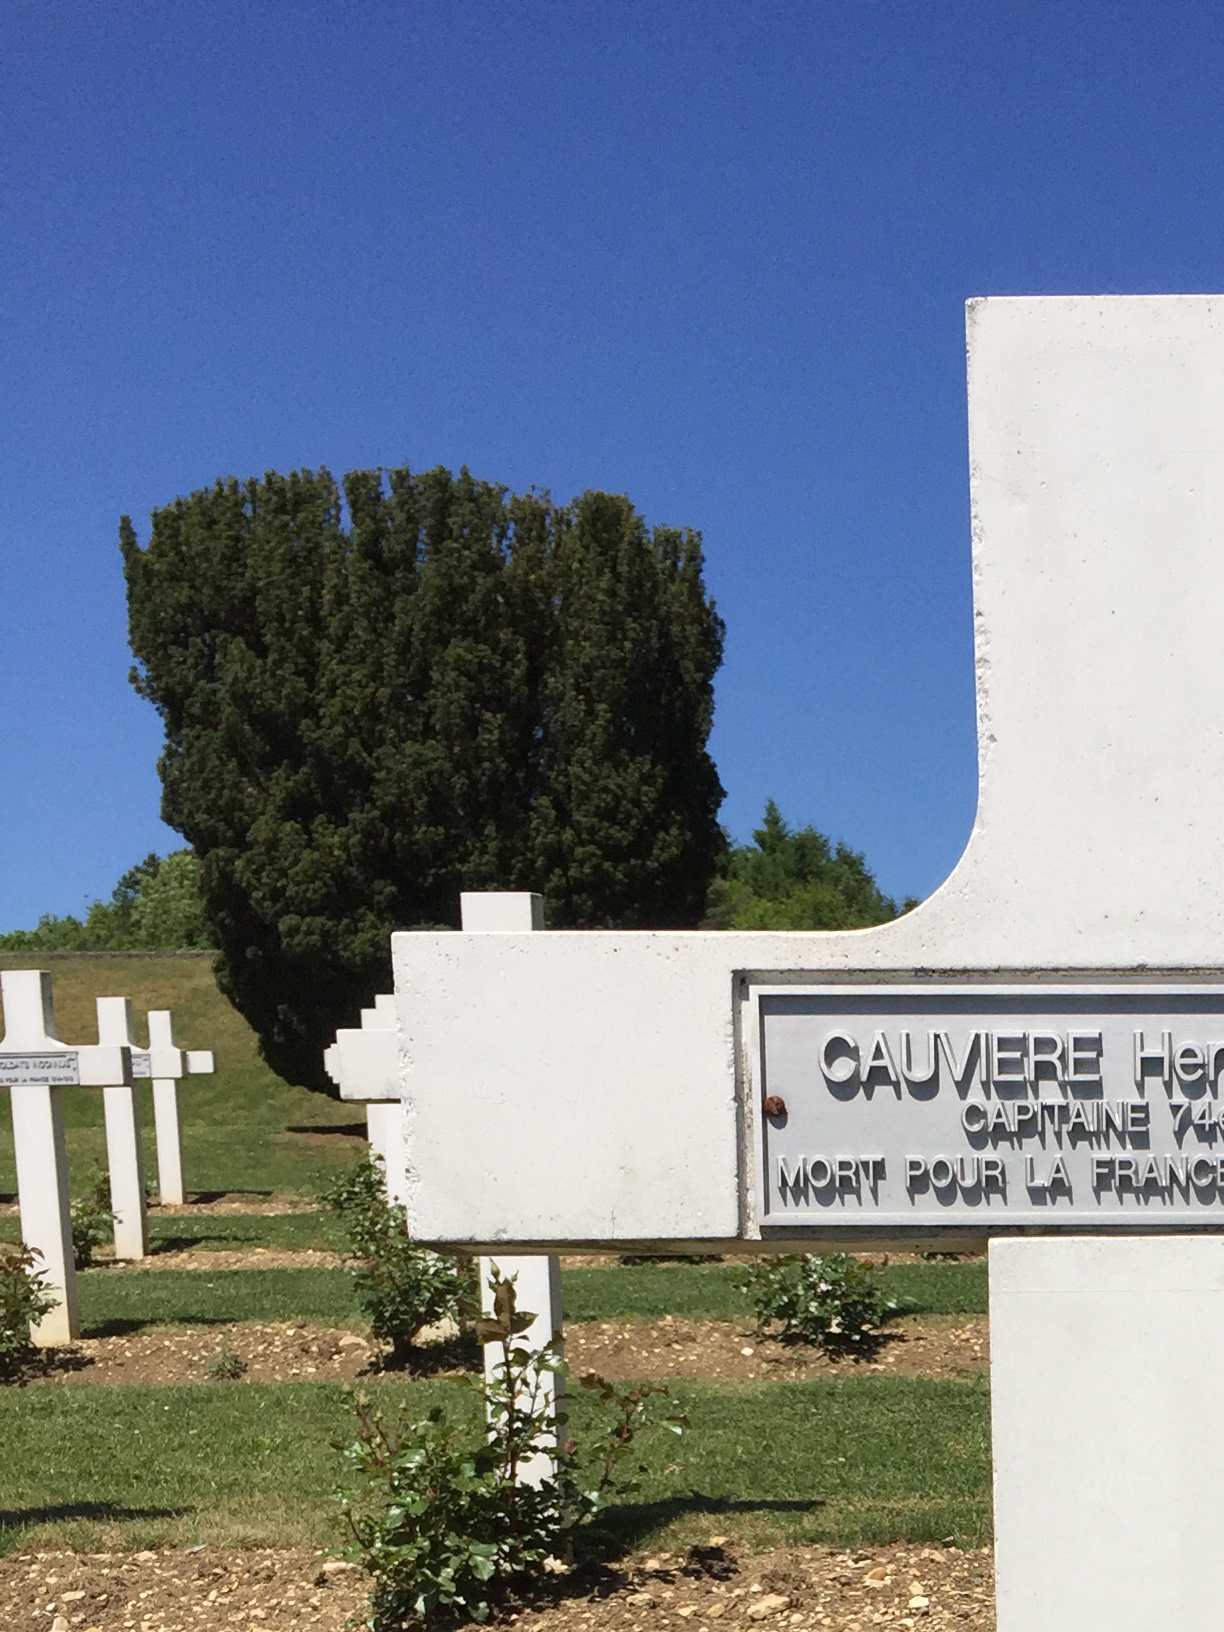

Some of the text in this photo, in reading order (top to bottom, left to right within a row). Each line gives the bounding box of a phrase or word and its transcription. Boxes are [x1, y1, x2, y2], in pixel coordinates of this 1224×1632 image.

[818, 1030, 1103, 1083] CAUVIERE
[960, 1099, 1150, 1133] CAPITAINE
[776, 1155, 886, 1188] MORT
[905, 1155, 1006, 1187] POUR
[1025, 1155, 1072, 1187] LA
